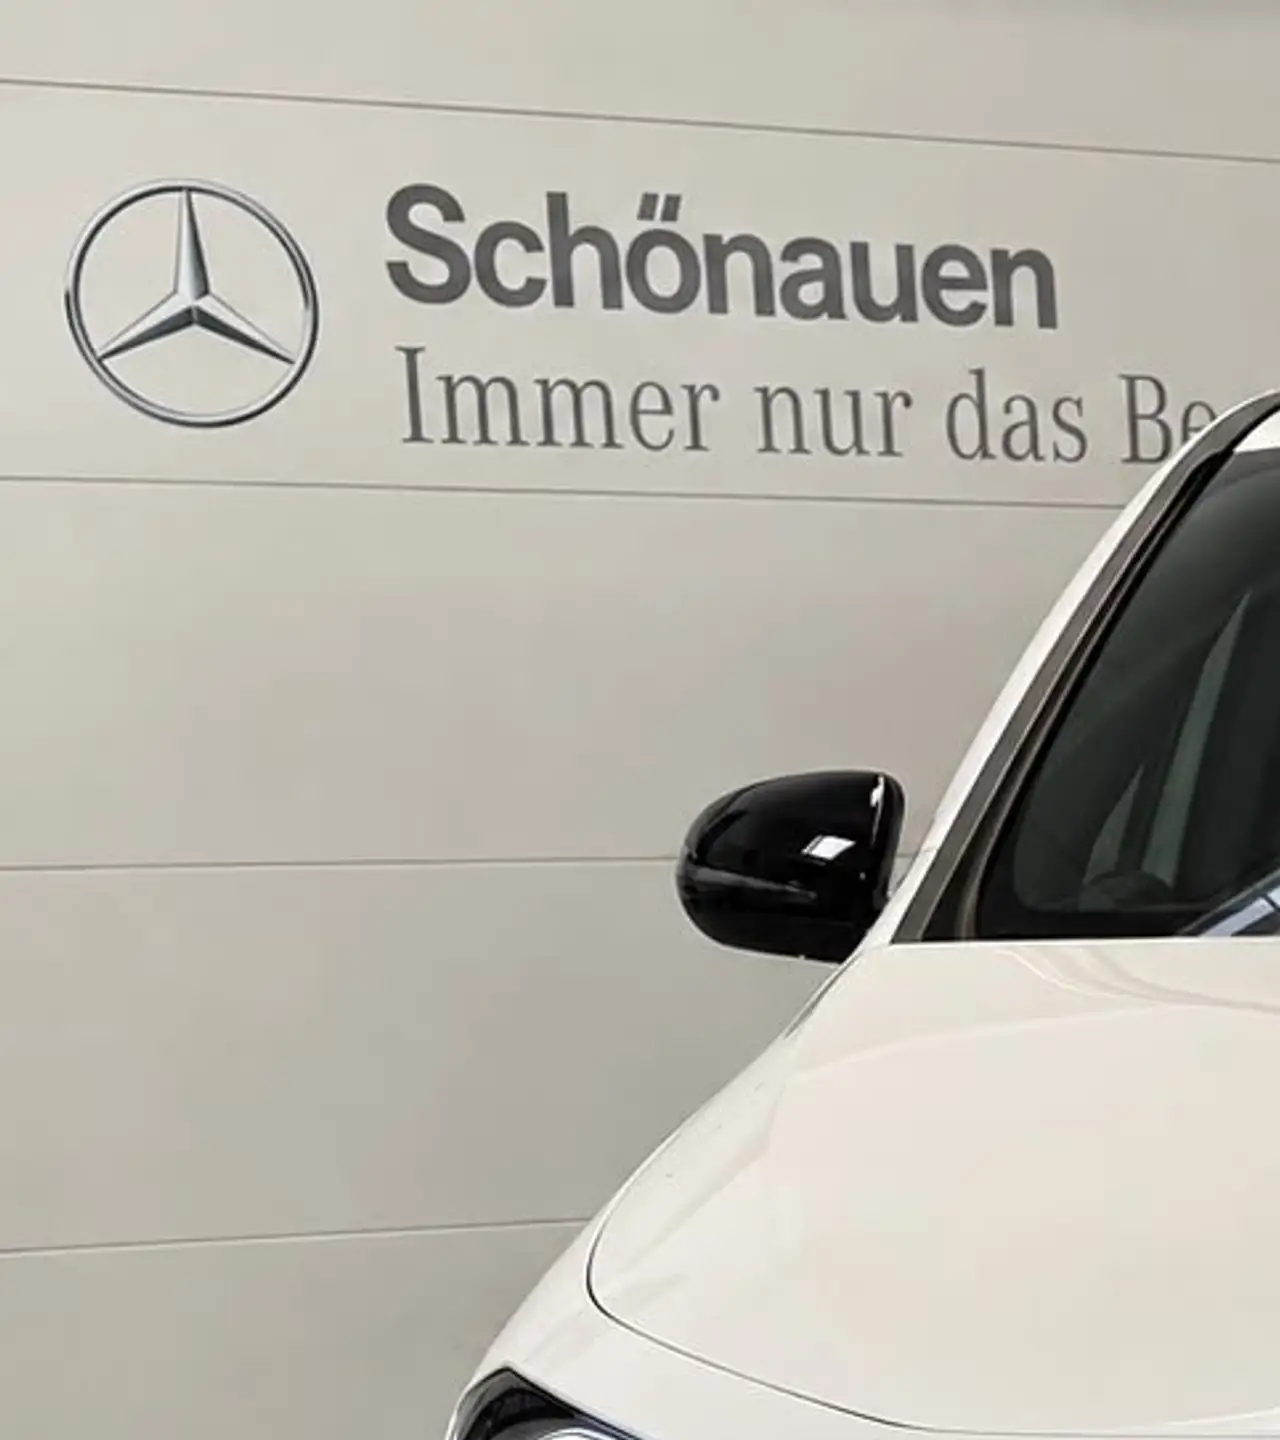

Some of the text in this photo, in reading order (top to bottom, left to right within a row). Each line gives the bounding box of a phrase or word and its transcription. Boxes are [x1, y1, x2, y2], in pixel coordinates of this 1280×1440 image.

[387, 183, 1058, 330] Schönauen
[396, 346, 720, 453] Immer
[755, 386, 913, 457] nur
[946, 368, 1088, 463] das
